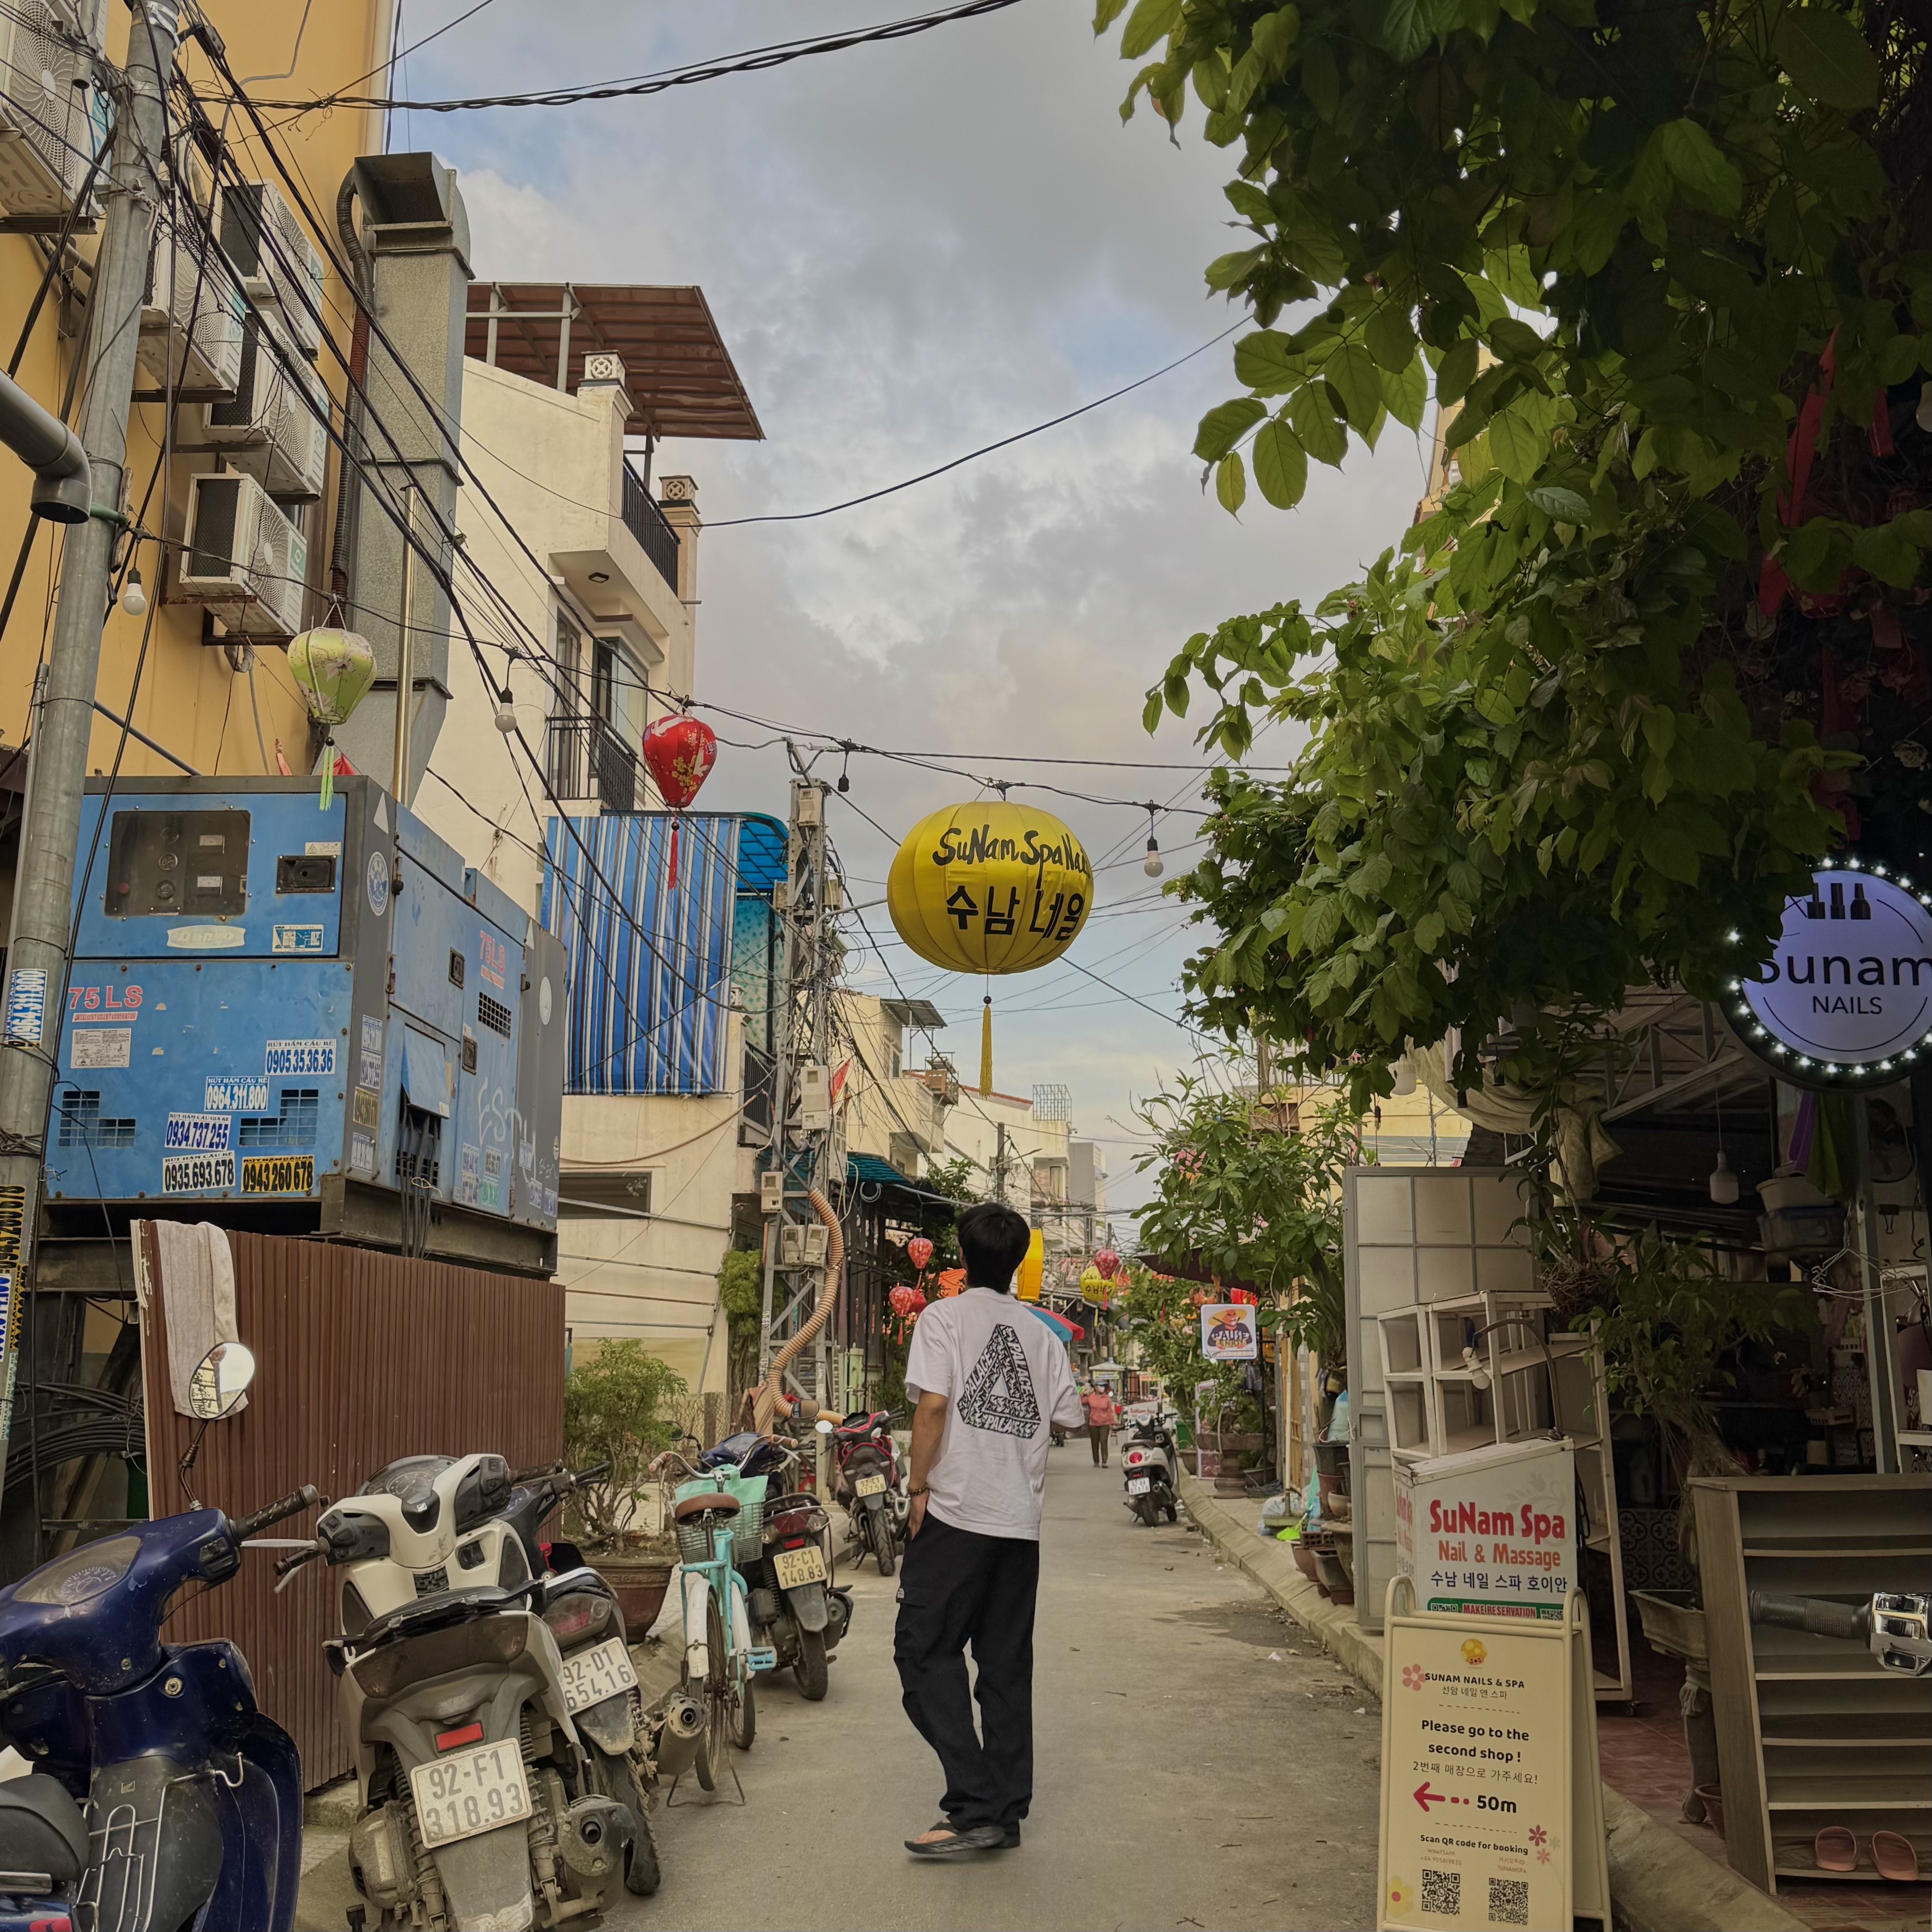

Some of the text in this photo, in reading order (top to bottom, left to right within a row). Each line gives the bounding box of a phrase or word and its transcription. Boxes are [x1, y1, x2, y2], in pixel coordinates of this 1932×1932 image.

[933, 824, 1019, 866] SuNam
[1020, 830, 1063, 889] Spa
[1813, 996, 1882, 1015] NAILS
[267, 1049, 333, 1074] 0905.35.36.36
[207, 1085, 267, 1109] 0964.311.800
[166, 1120, 229, 1149] 0934.737.255
[165, 1158, 234, 1191] 0935.693.678
[1214, 1330, 1248, 1340] PAUSE
[1430, 1499, 1514, 1536] SuNam
[1521, 1504, 1565, 1545] Spa
[782, 1550, 816, 1569] 92-C1
[1438, 1540, 1560, 1572] Nail & Massage
[782, 1565, 823, 1586] 148.83
[1431, 1571, 1567, 1594] 수남 네일 스파 호이안
[1462, 1603, 1537, 1618] MAKE RESERVATION
[563, 1647, 614, 1686] 92-D1
[565, 1664, 632, 1711] 654.16
[1425, 1673, 1460, 1683] SUNAM
[1464, 1676, 1492, 1686] NAILS
[1505, 1680, 1525, 1689] SPA
[1461, 1688, 1477, 1697] 네일
[1480, 1689, 1488, 1698] 앤
[1491, 1691, 1507, 1700] 스파
[1422, 1720, 1529, 1741] Please go to the
[1428, 1744, 1521, 1763] second shop !
[428, 1749, 505, 1800] 92-F1
[1413, 1761, 1538, 1784] 2번째 매장으로 가주세요!
[425, 1783, 524, 1840] 318.93
[1477, 1795, 1516, 1813] 50m
[1420, 1834, 1528, 1855] Scan QR code for booking
